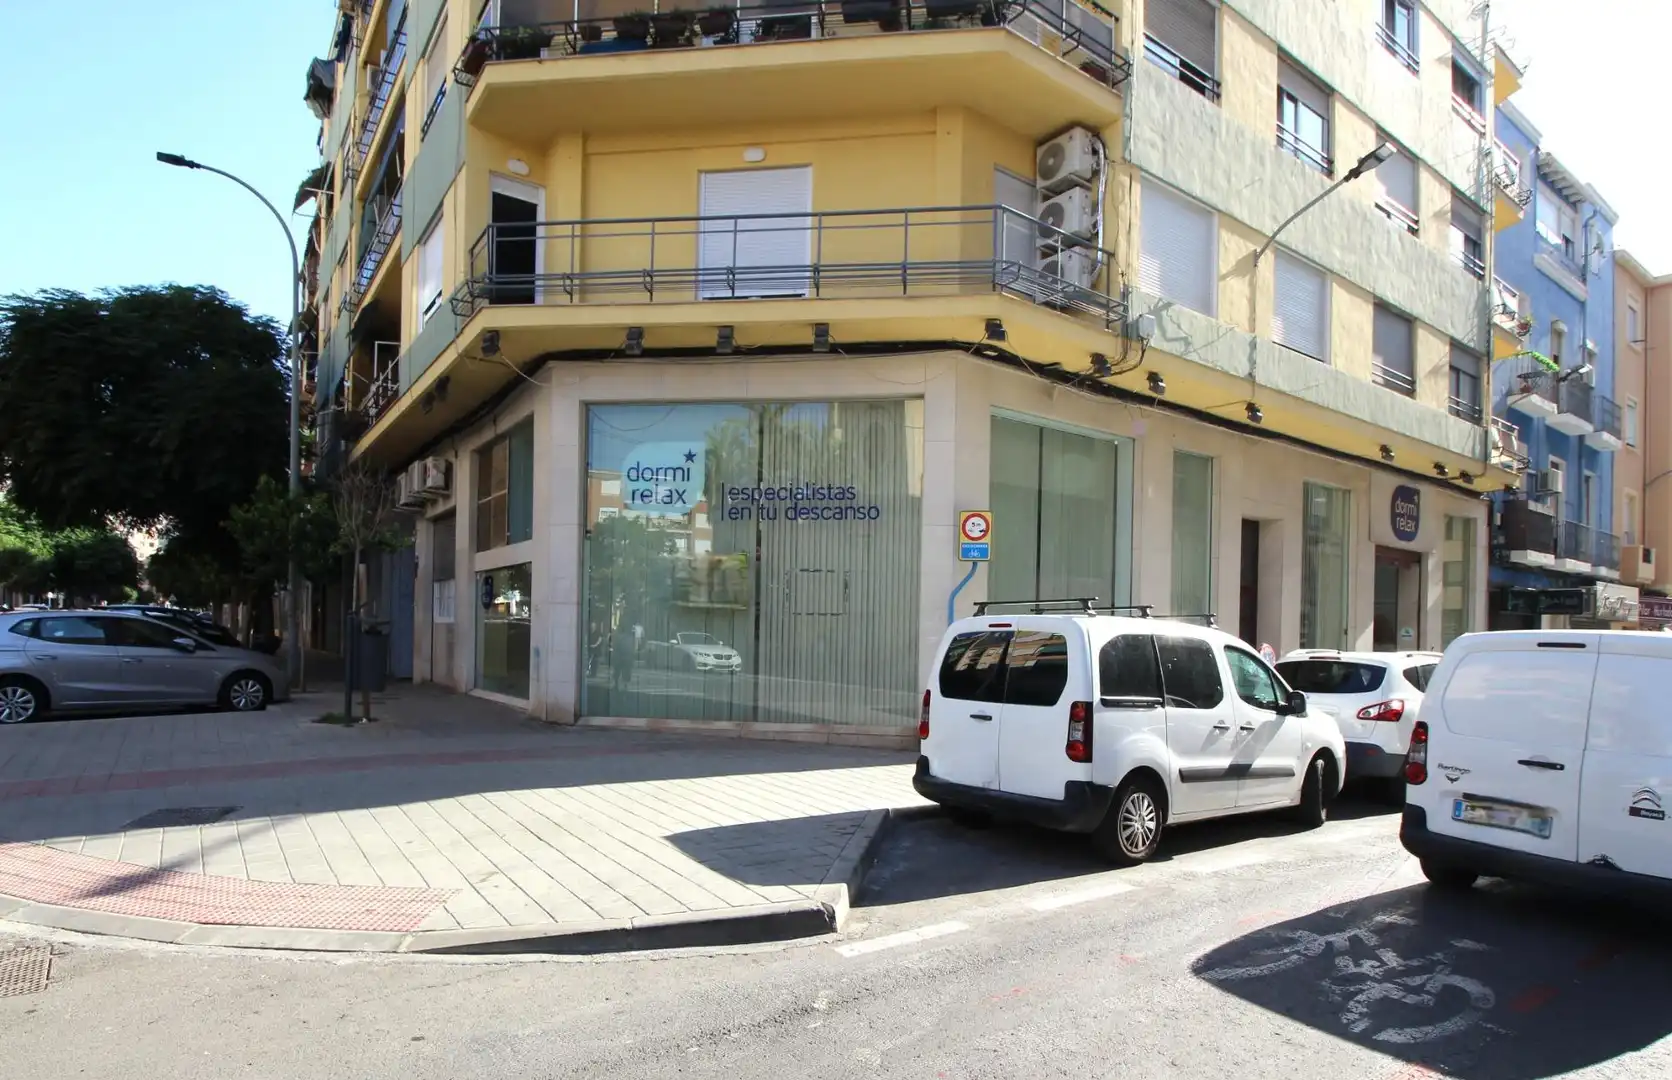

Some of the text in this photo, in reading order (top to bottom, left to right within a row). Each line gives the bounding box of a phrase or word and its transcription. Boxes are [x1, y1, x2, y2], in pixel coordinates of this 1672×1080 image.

[627, 461, 691, 482] dormi
[631, 484, 687, 505] relax
[728, 482, 857, 504] especialistas
[728, 501, 881, 521] en tu descanso
[1395, 496, 1417, 516] dormi
[1396, 517, 1416, 532] relax
